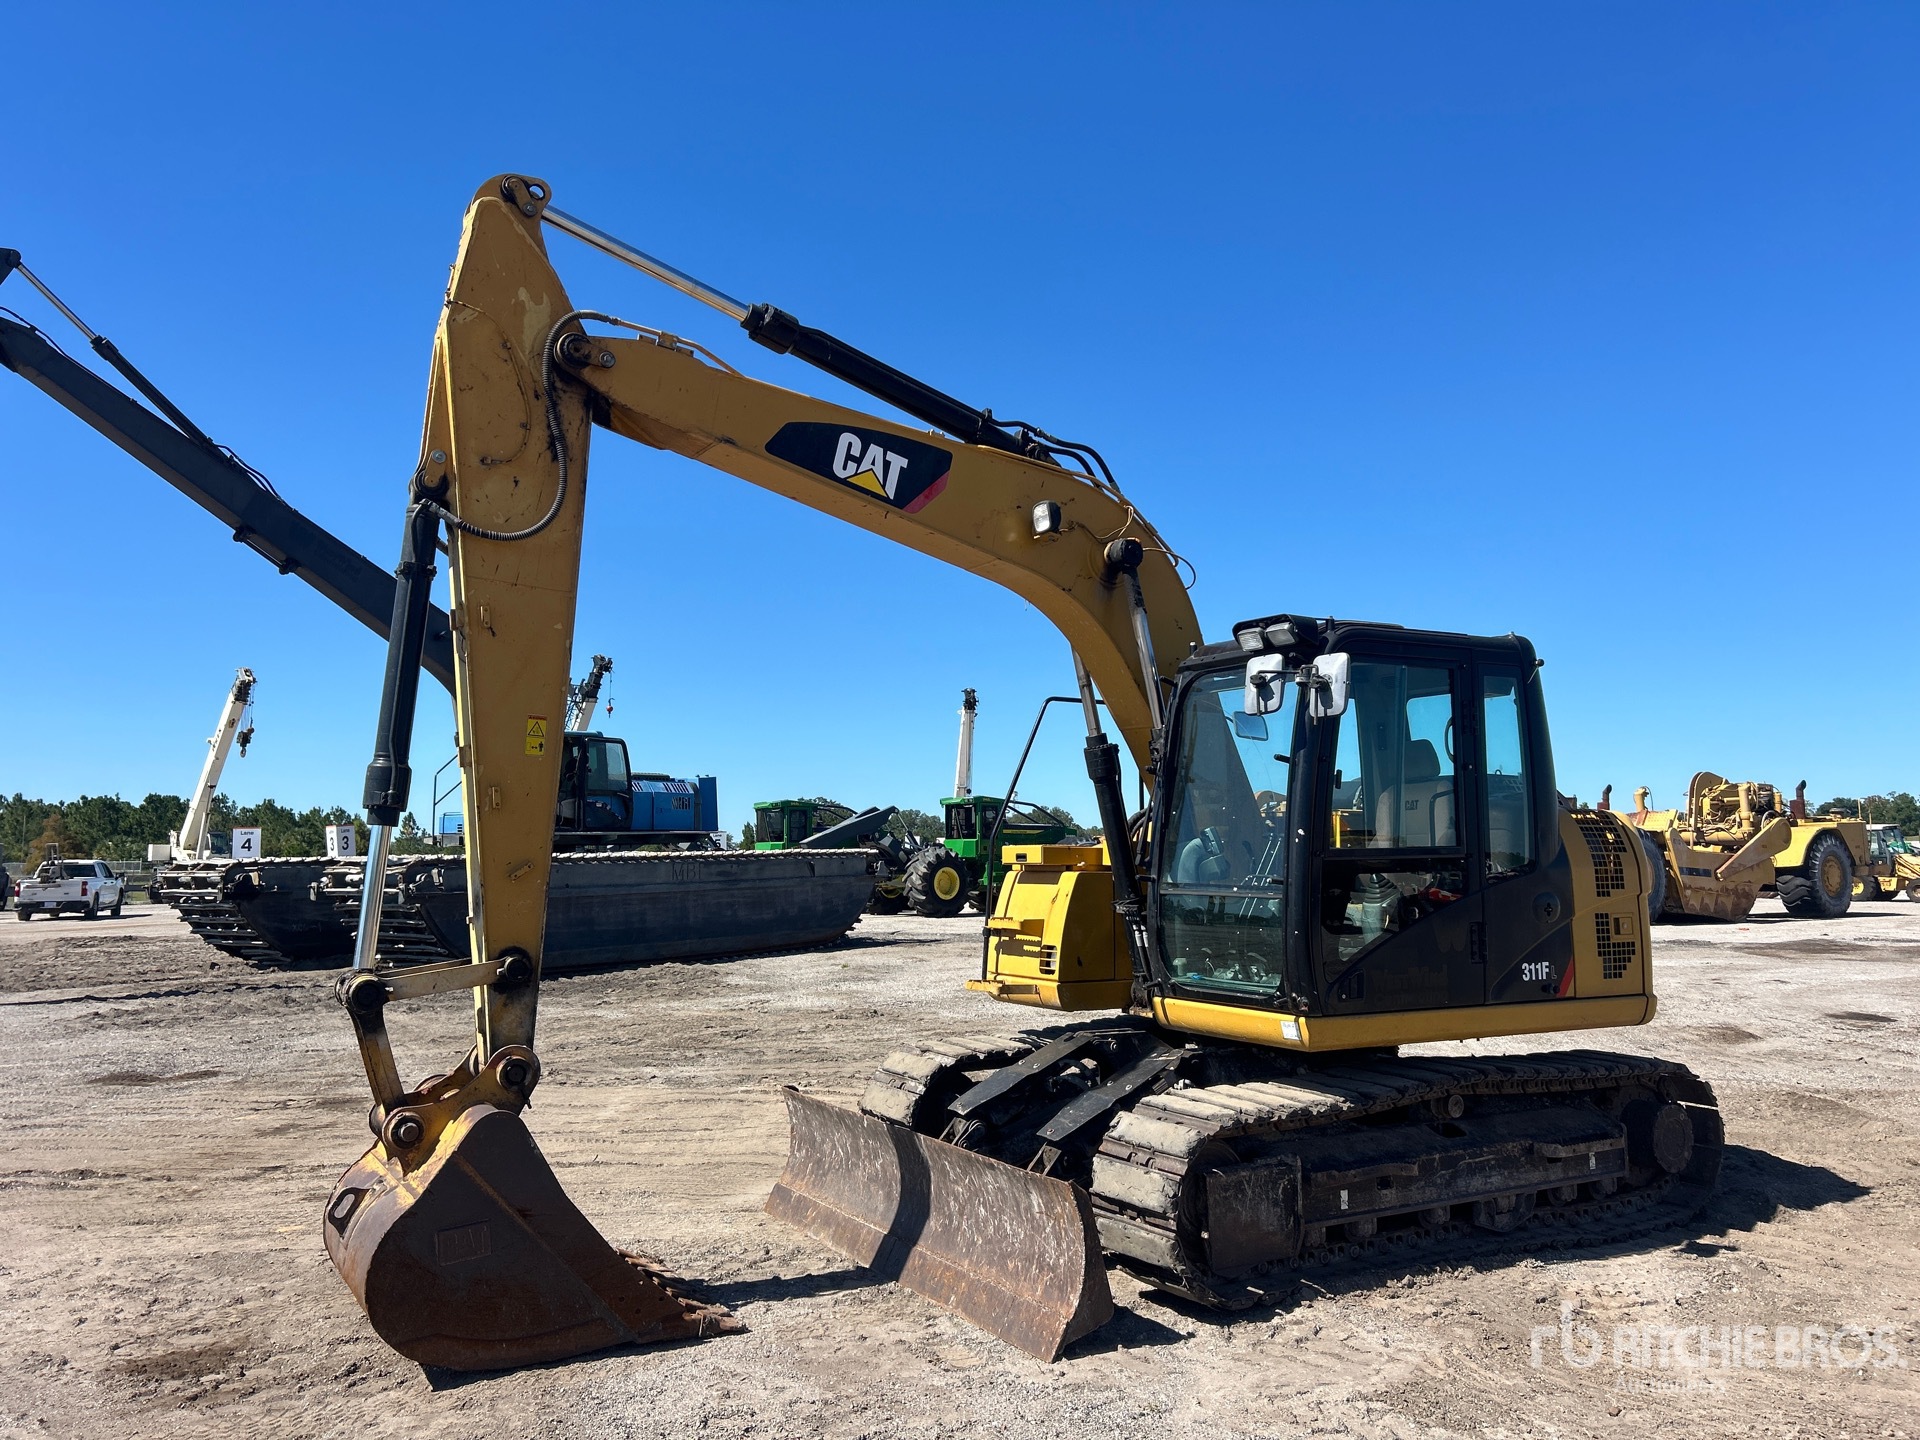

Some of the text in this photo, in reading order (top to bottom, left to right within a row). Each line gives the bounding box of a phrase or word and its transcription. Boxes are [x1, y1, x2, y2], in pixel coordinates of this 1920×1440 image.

[833, 432, 908, 500] CAT
[1405, 800, 1419, 810] CAT
[240, 838, 252, 851] 4
[329, 837, 335, 851] 3
[341, 836, 349, 850] 3
[1522, 962, 1549, 981] 311F
